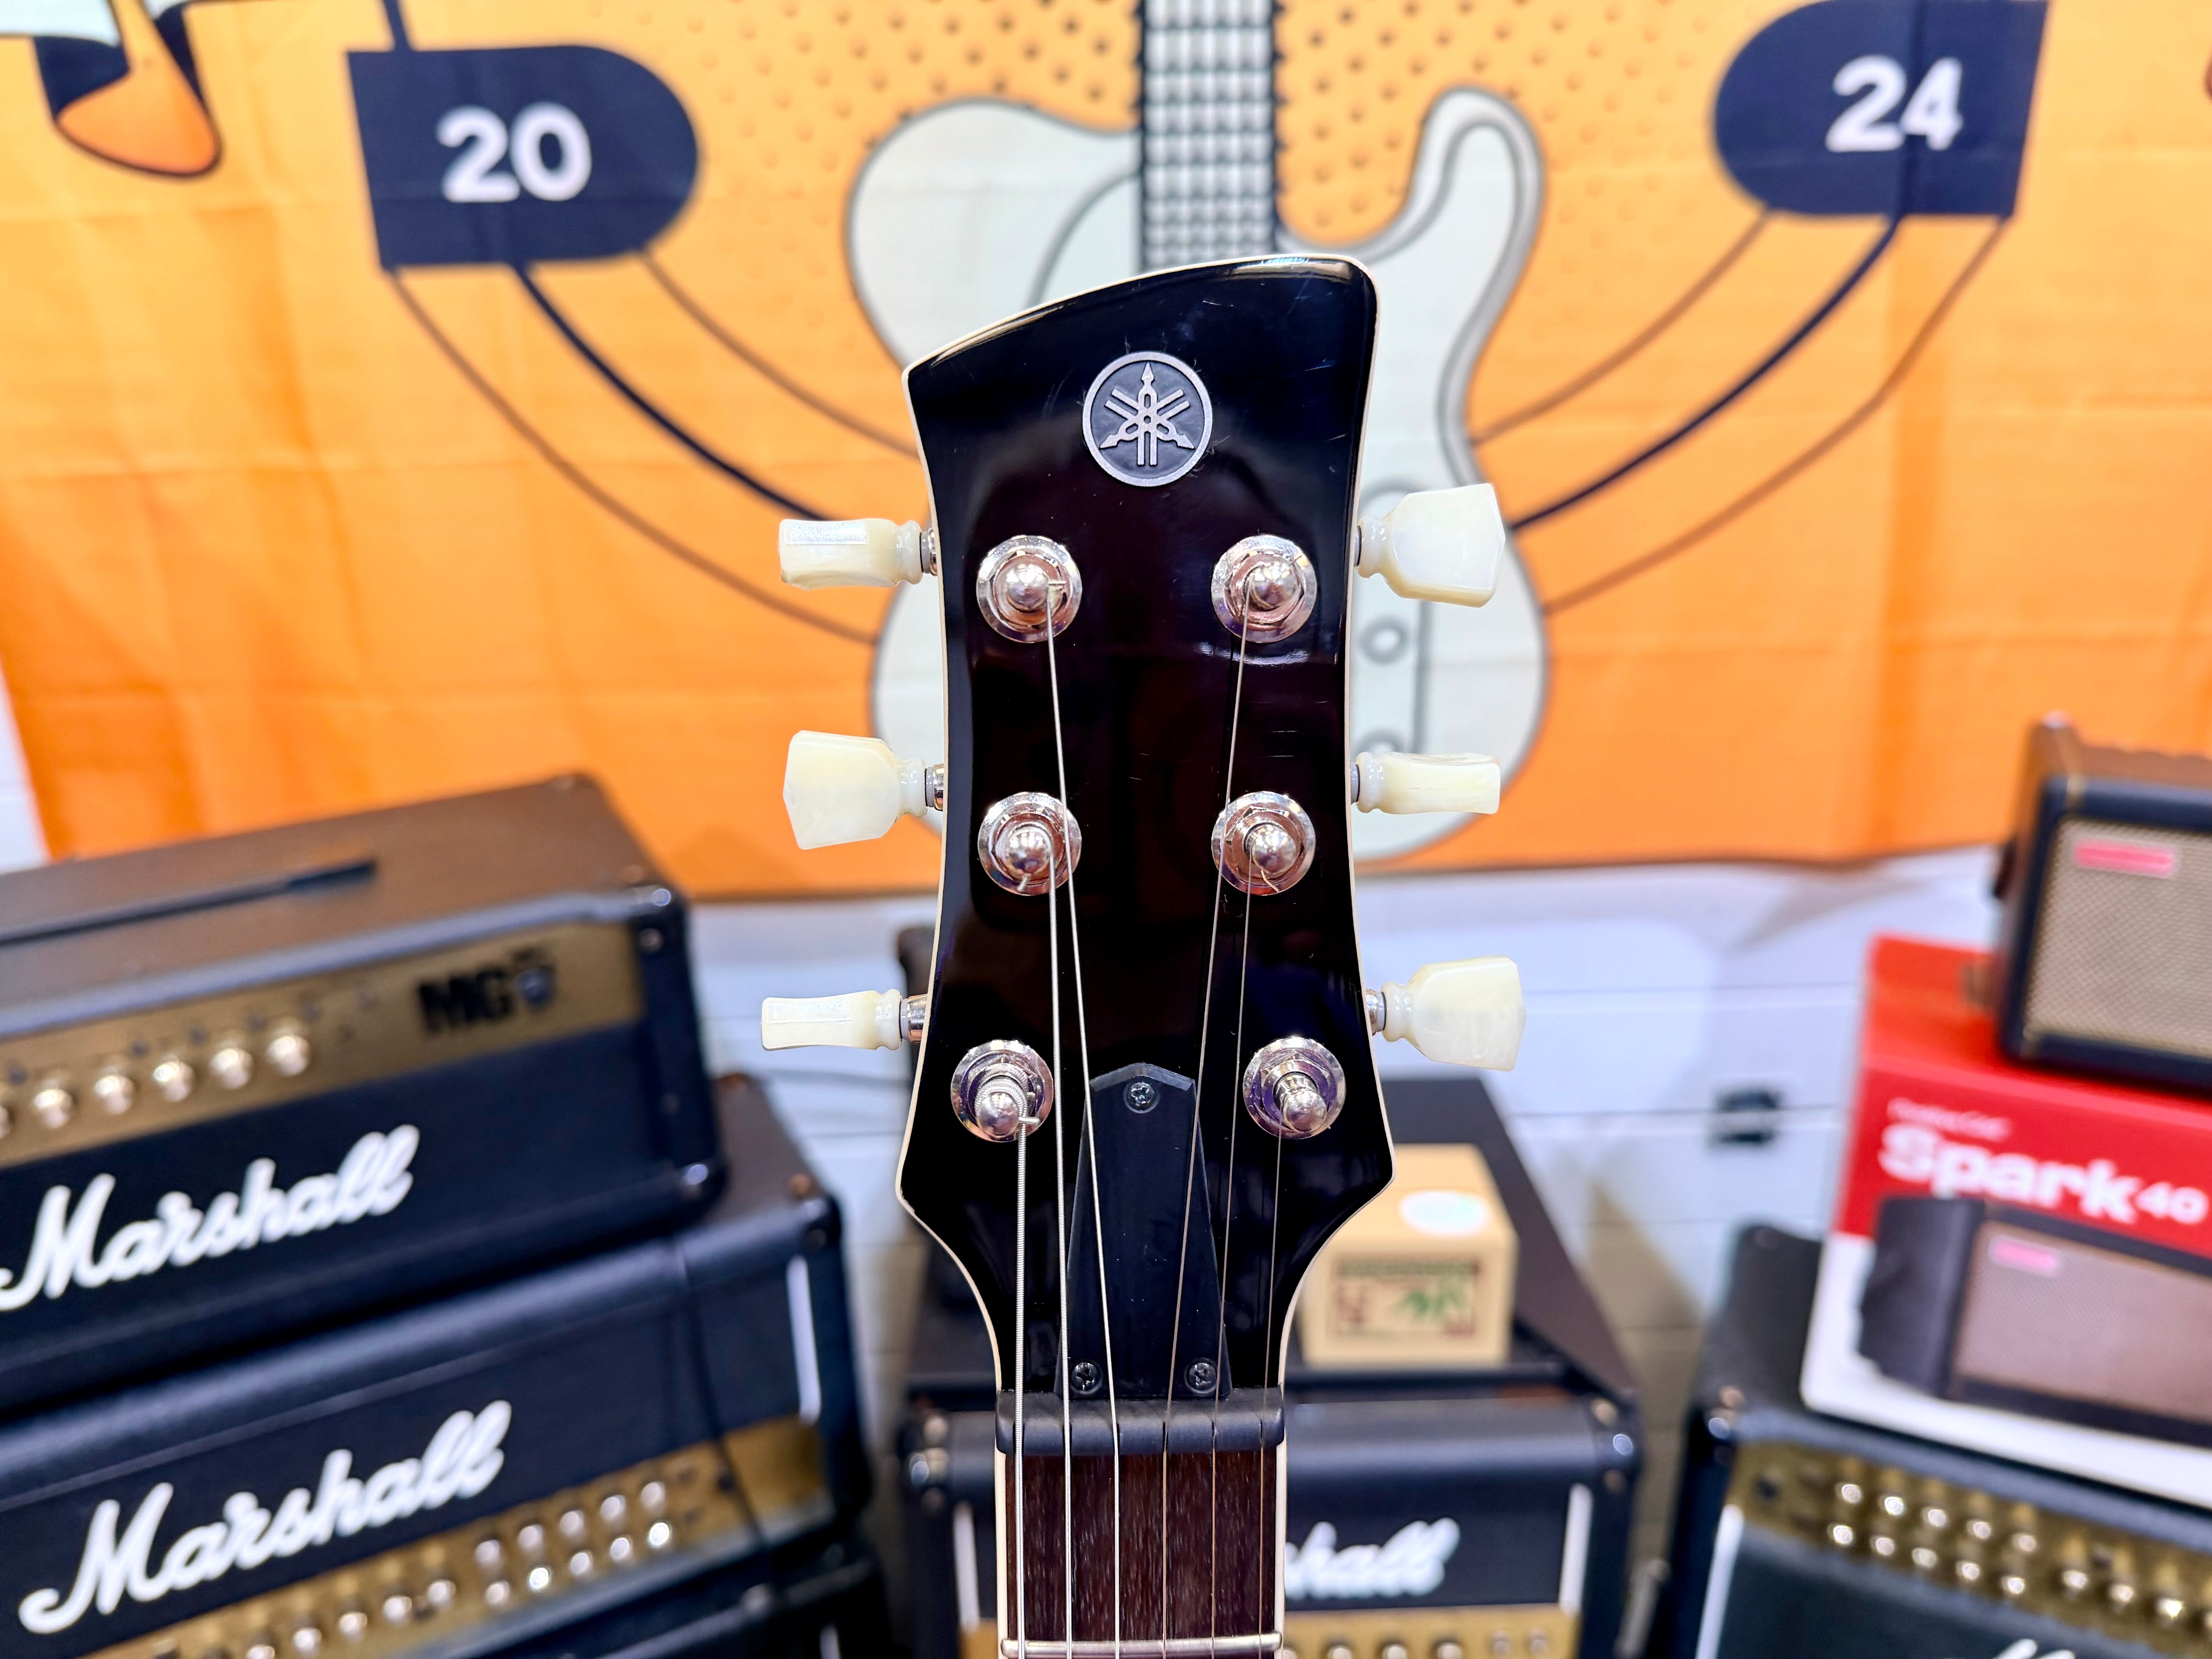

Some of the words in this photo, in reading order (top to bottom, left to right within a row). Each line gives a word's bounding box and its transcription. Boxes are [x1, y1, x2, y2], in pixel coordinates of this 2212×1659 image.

[437, 104, 592, 203] 20
[1825, 55, 1962, 153] 24
[0, 1125, 420, 1311] Marshall
[1878, 1121, 2143, 1224] Spark
[2135, 1180, 2210, 1224] 40
[18, 1400, 512, 1634] Marshall
